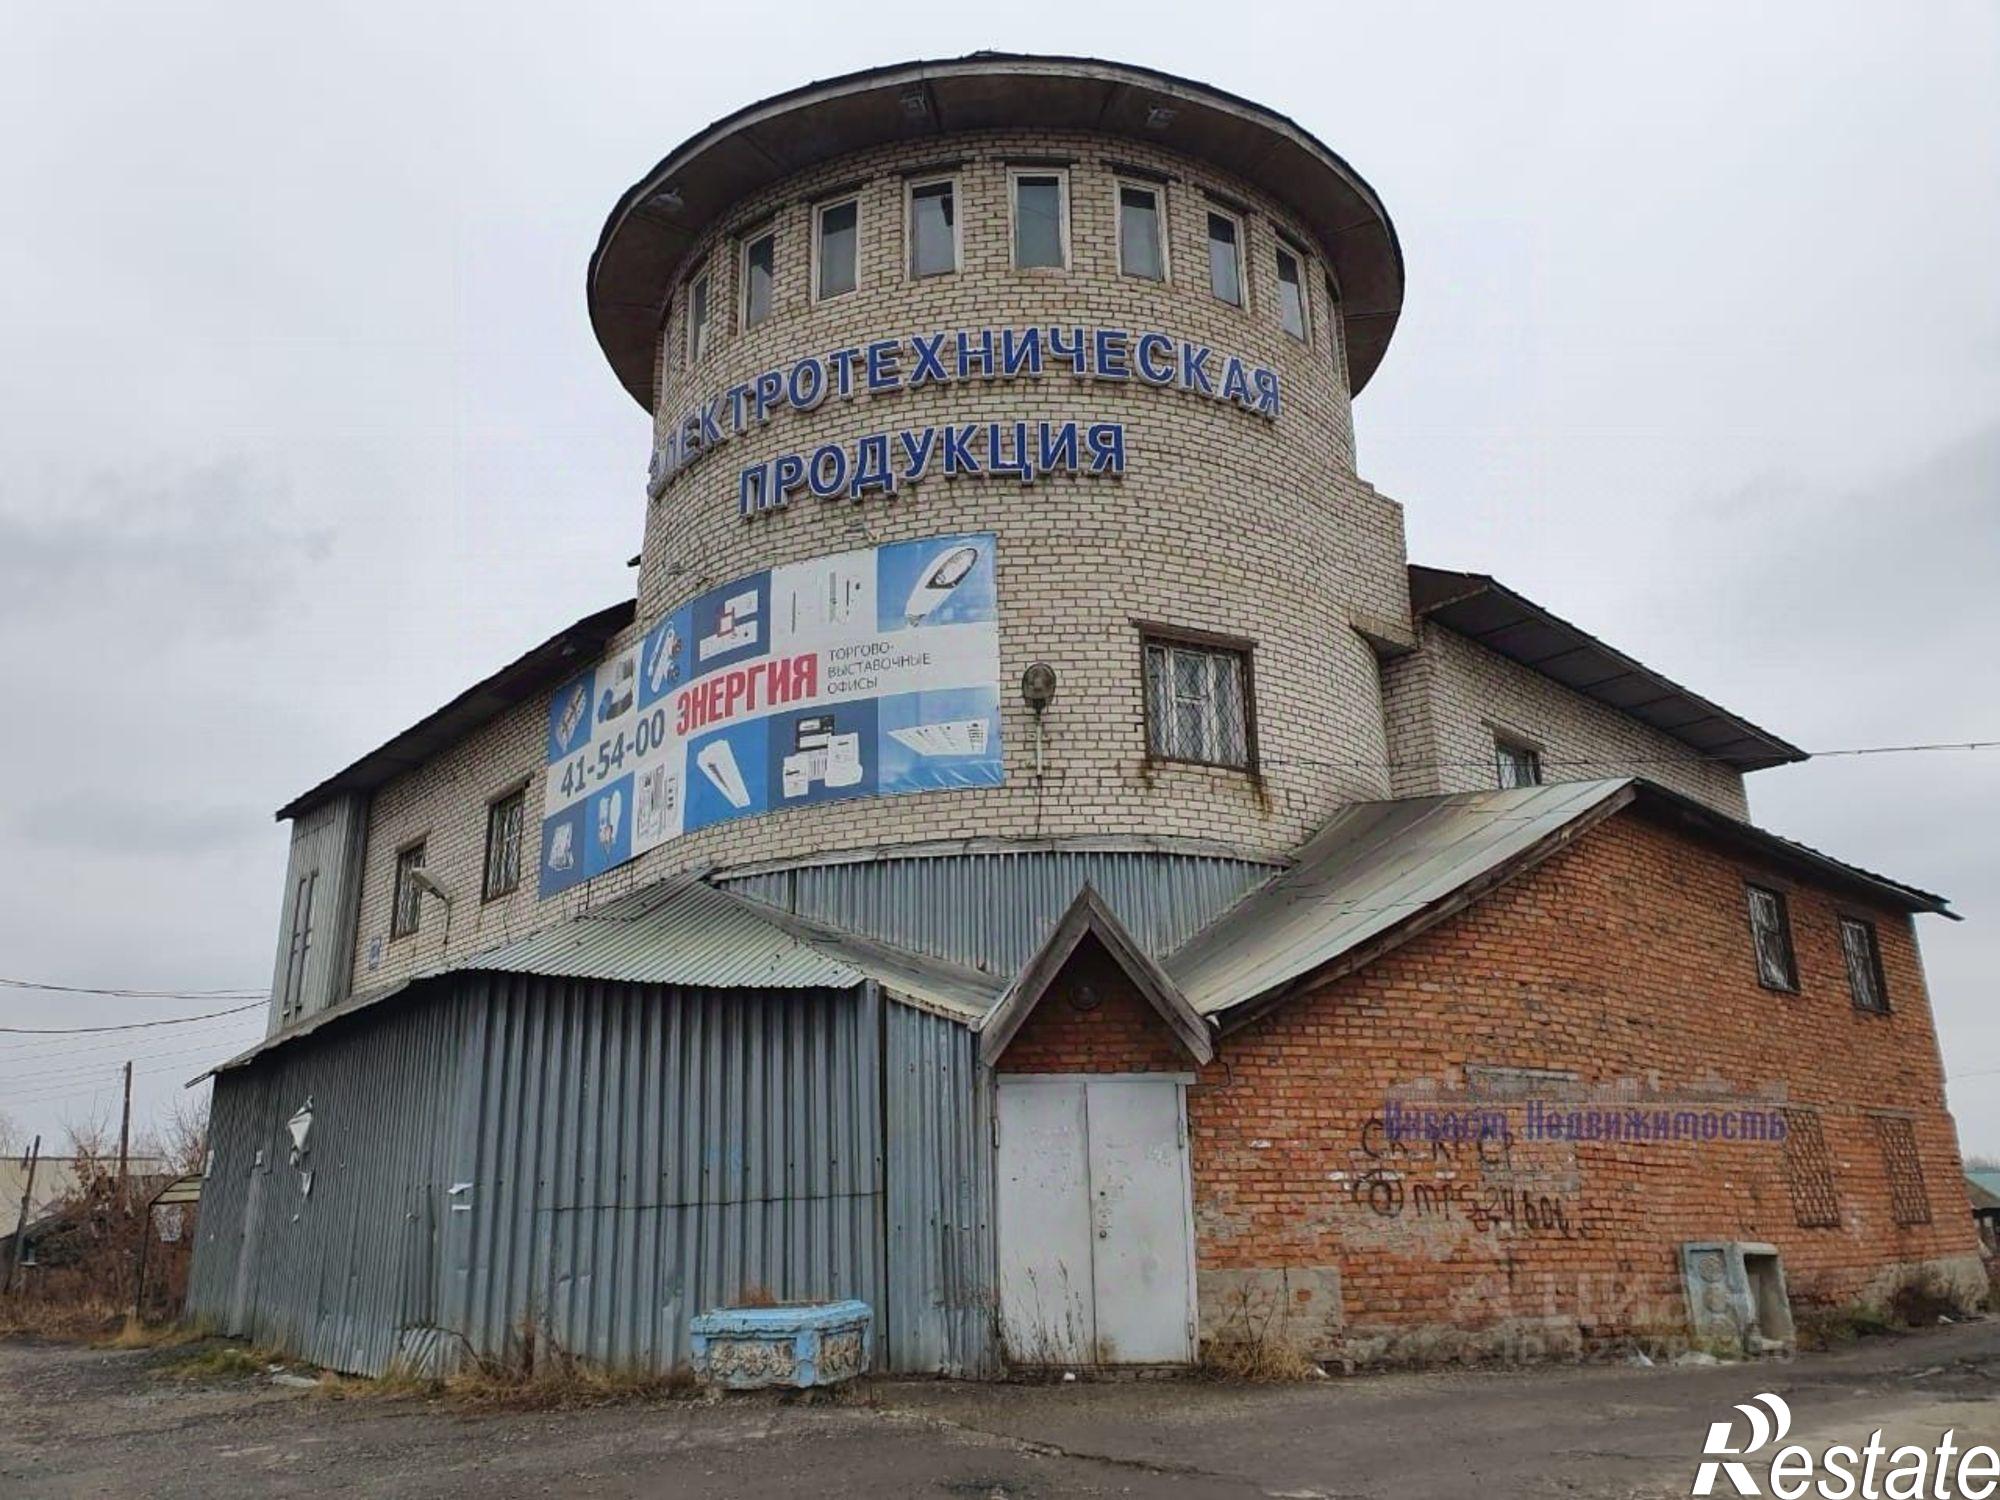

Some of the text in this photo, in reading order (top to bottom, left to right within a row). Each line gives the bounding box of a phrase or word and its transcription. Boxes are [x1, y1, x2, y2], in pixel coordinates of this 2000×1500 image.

[739, 422, 1126, 519] ПРОДУКЦИЯ
[828, 653, 932, 678] ВЫСТАВОЧНЫЕ
[829, 641, 894, 661] ТОРГОВО-
[676, 652, 818, 736] ЭНЕРГИЯ
[827, 676, 878, 695] ОФИСЫ
[560, 708, 665, 798] 41-54-00
